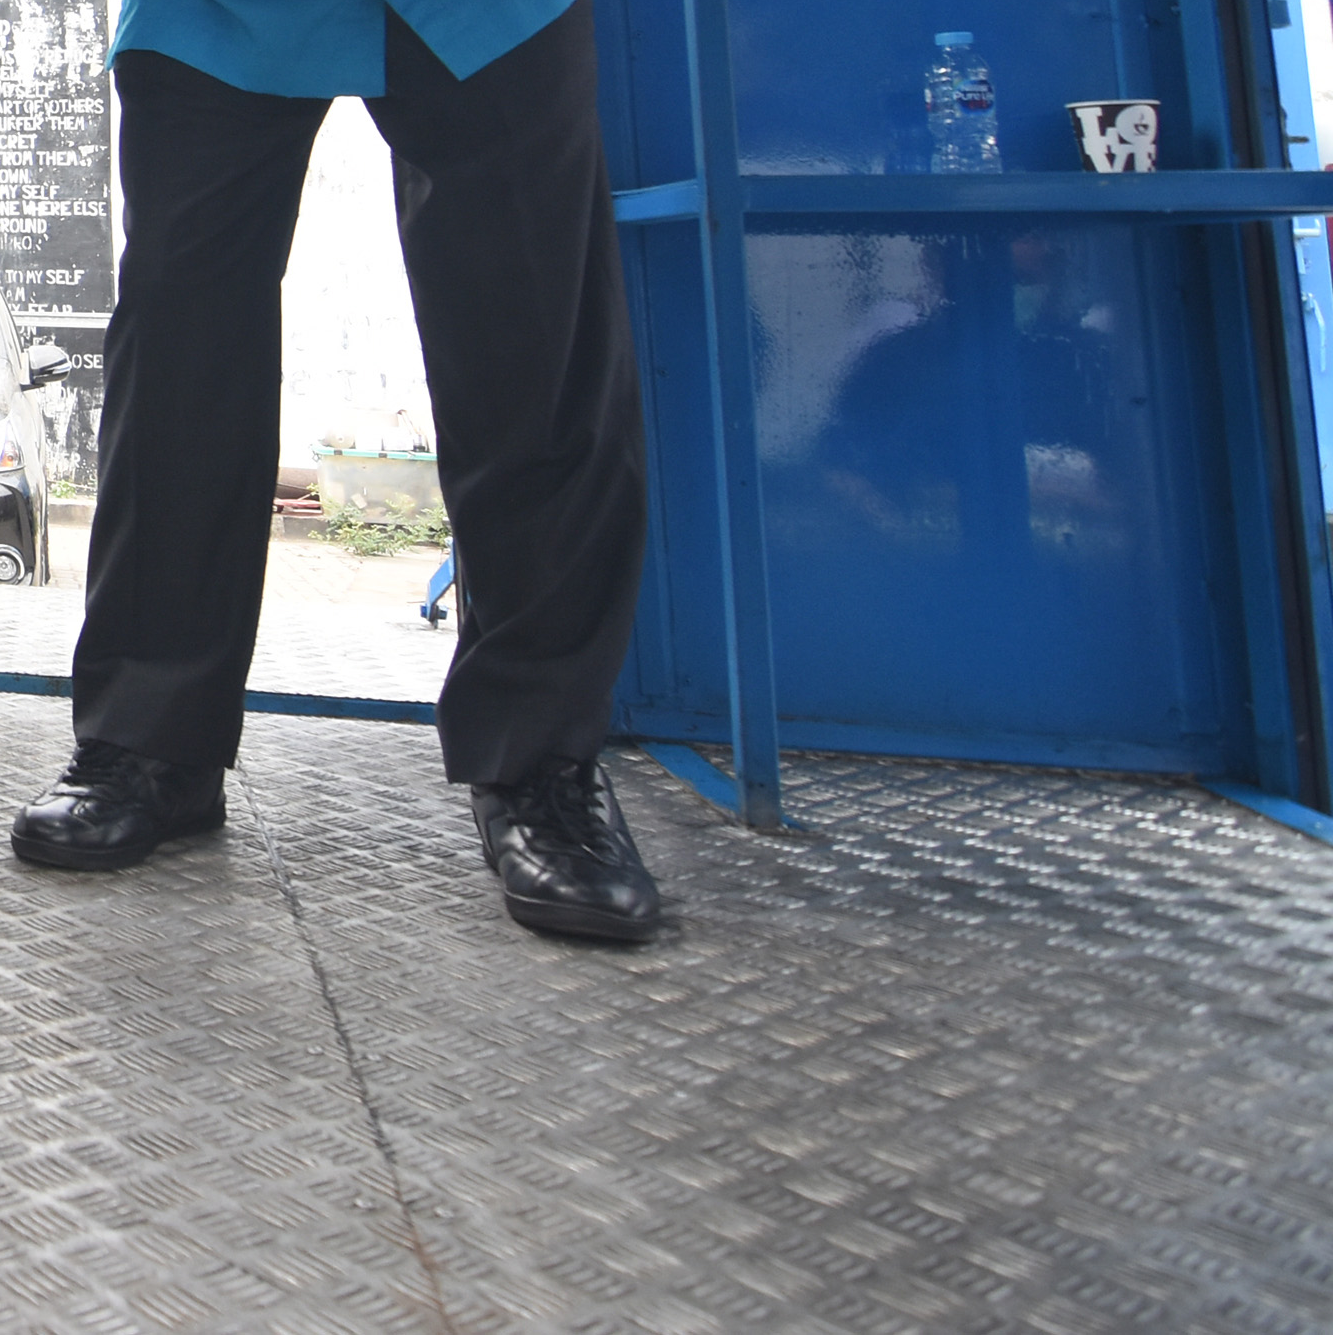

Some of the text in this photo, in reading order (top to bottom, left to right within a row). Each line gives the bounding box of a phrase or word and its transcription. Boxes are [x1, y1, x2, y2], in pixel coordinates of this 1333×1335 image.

[23, 99, 44, 116] OF
[49, 97, 105, 115] OTHERS
[49, 116, 85, 131] THEM
[21, 184, 61, 201] SELF
[21, 200, 72, 217] WHERE
[73, 201, 108, 217] ELSE
[5, 269, 24, 284] TO
[25, 269, 44, 285] MY
[45, 269, 86, 286] SELF
